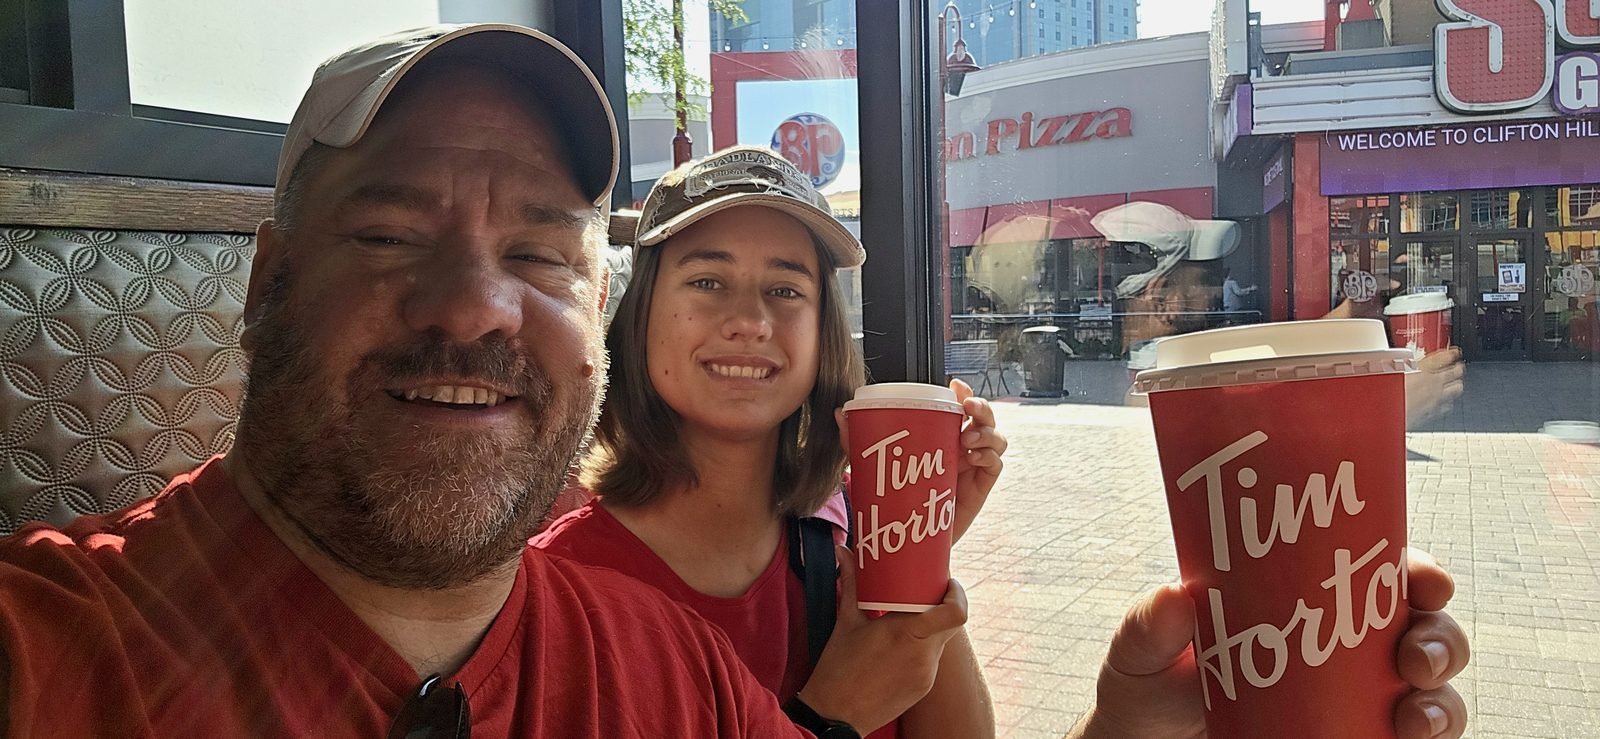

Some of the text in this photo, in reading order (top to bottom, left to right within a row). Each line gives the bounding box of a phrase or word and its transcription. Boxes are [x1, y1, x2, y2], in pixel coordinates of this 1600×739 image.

[778, 120, 843, 177] BP
[985, 106, 1134, 156] Pizza
[1338, 129, 1437, 151] WELCOME
[1441, 128, 1468, 145] TO
[1473, 122, 1560, 143] CLIFTON
[861, 429, 946, 497] Tim
[856, 488, 957, 570] Horto
[1176, 430, 1366, 572] Tim
